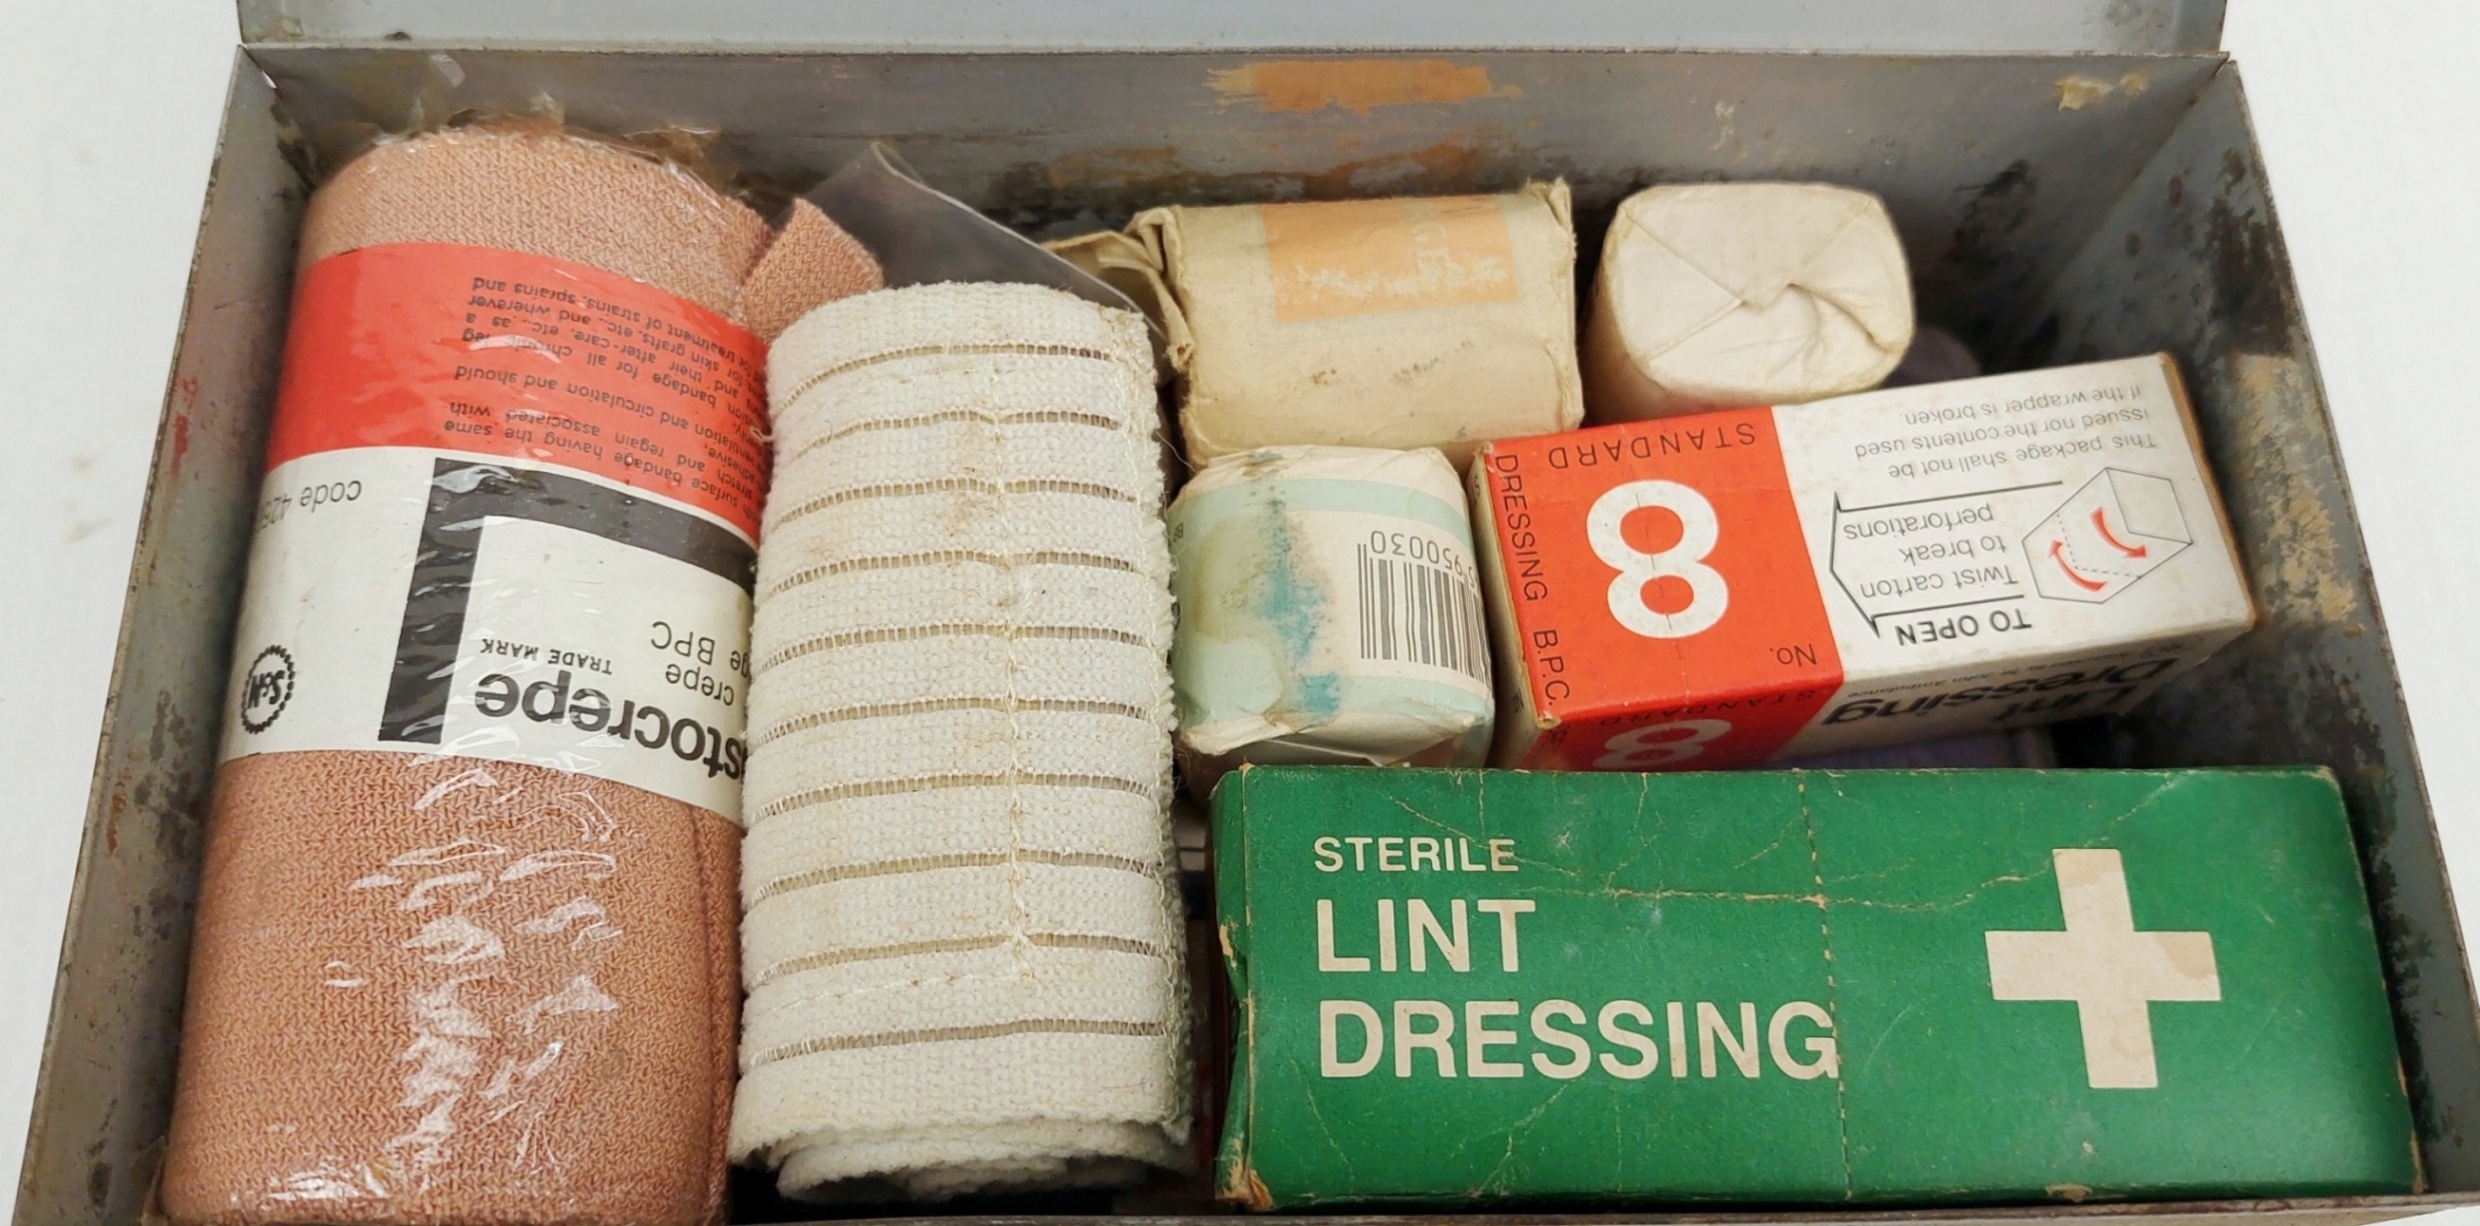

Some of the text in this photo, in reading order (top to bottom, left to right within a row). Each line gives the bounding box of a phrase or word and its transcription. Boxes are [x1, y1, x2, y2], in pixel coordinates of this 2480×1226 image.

[472, 276, 507, 292] and
[513, 283, 576, 307] sprains
[465, 311, 477, 324] a
[467, 294, 551, 317] wherever
[491, 315, 512, 329] as
[558, 308, 591, 326] and
[645, 315, 663, 330] of
[461, 326, 491, 346] leg
[667, 323, 735, 363] treatment
[586, 351, 608, 367] all
[615, 360, 639, 379] for
[668, 361, 703, 384] their
[690, 350, 720, 372] skin
[726, 367, 744, 386] for
[651, 372, 717, 409] bandage
[713, 379, 739, 399] and
[1897, 383, 2142, 429] if the wrapper is broken.
[453, 365, 756, 467] ventilation and circulation and should
[1853, 406, 2150, 461] issued nor the contents used
[443, 420, 739, 510] surface bandage having the same
[449, 401, 753, 501] stretch and regain associated with
[1547, 422, 1757, 471] STANDARD
[1886, 430, 2158, 481] This package shall not be
[299, 479, 363, 514] code
[1842, 502, 1995, 542] perforations
[1369, 529, 1465, 575] 950030
[1585, 478, 1731, 640] 8
[1896, 534, 2007, 568] to break
[1494, 453, 1550, 603] DRESSING
[1532, 628, 1571, 708] B.P.C.
[1858, 563, 2019, 601] Twist carton
[649, 620, 716, 666] BPC
[1893, 607, 2033, 647] TO OPEN
[479, 637, 613, 676] TRADE MARK
[1768, 642, 1818, 667] No.
[663, 662, 735, 709] crepe
[1819, 656, 2180, 727] Dressing
[1597, 688, 1817, 728] STANDARD
[1591, 718, 1732, 769] 8
[1312, 836, 1520, 874] STERILE
[1315, 898, 1538, 973] LINT
[1317, 999, 1840, 1081] DRESSING
